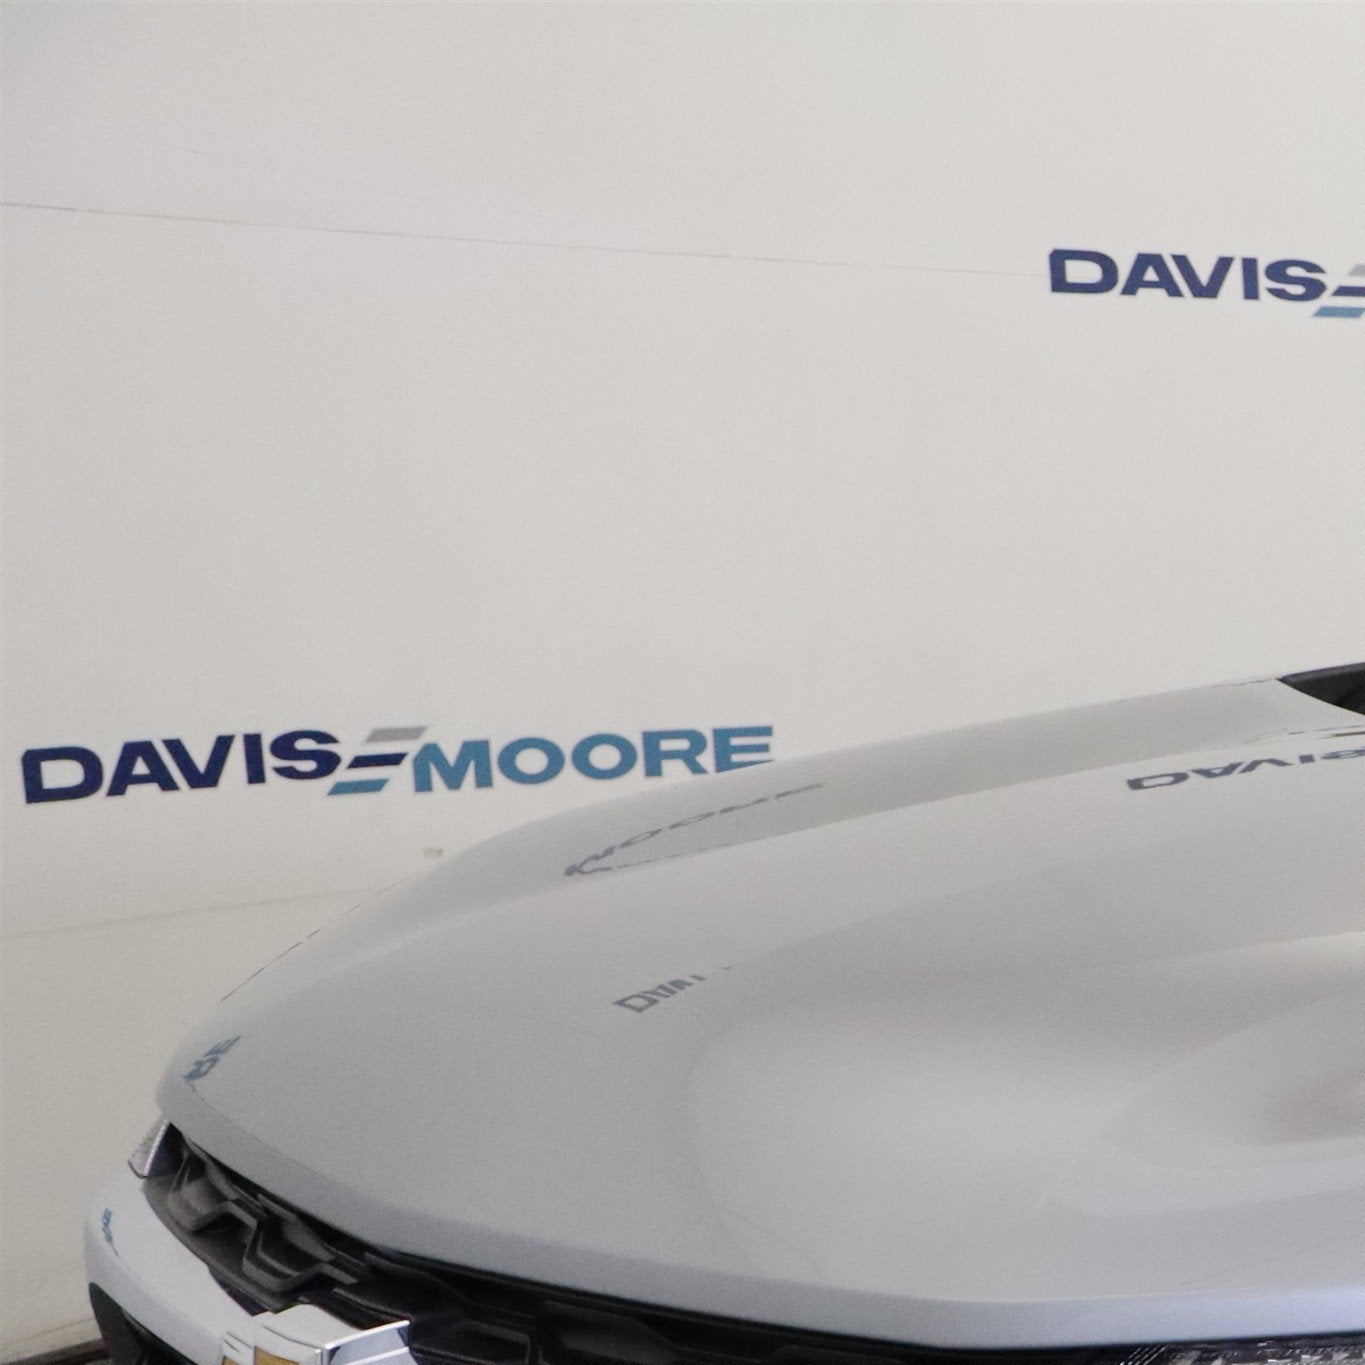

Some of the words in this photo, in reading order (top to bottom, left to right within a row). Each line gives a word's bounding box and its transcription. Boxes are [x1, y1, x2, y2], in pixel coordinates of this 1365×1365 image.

[1048, 249, 1326, 301] DAVIS
[22, 729, 338, 804] DAVIS
[413, 725, 775, 792] MOORE
